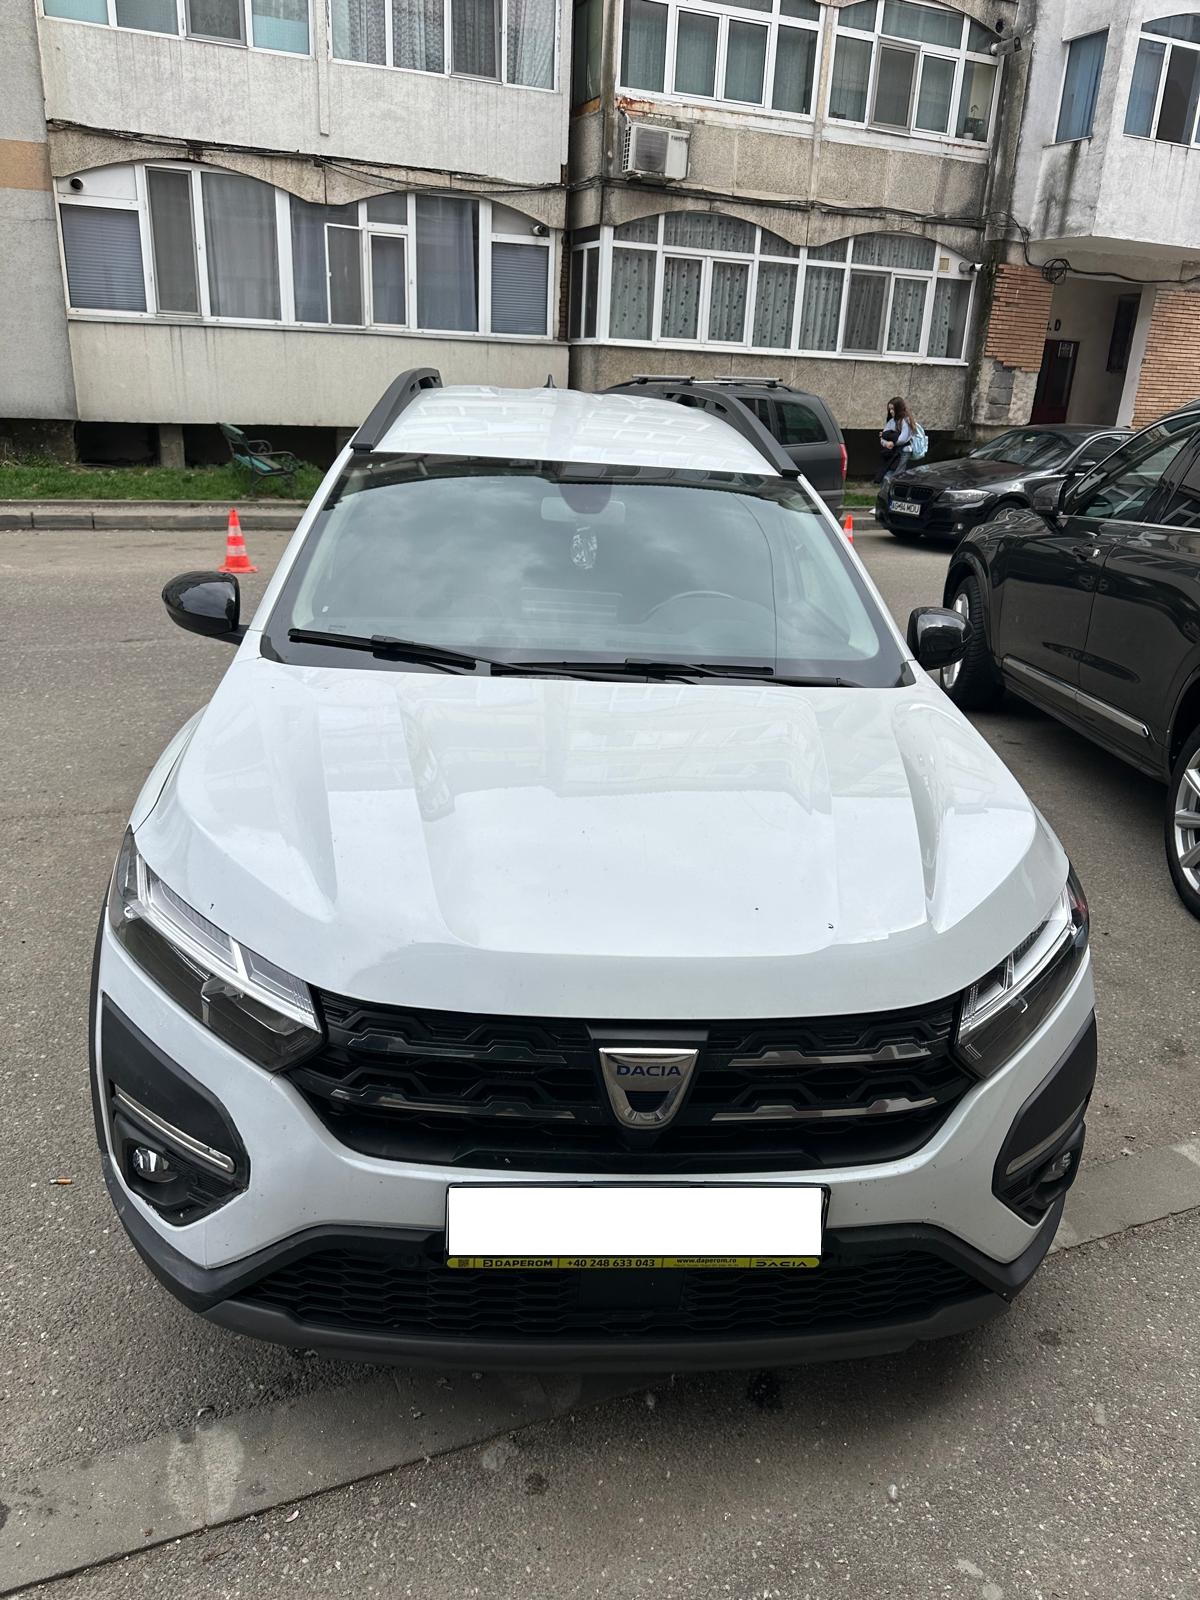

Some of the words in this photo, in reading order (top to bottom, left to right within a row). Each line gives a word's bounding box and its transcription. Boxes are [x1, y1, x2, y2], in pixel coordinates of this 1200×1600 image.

[616, 1065, 681, 1077] DACIA
[495, 1259, 553, 1267] DAPEROM
[567, 1259, 587, 1267] +40
[590, 1259, 610, 1267] 248
[612, 1259, 632, 1267] 633
[635, 1259, 655, 1267] 043
[676, 1257, 737, 1265] www.daperom.ro
